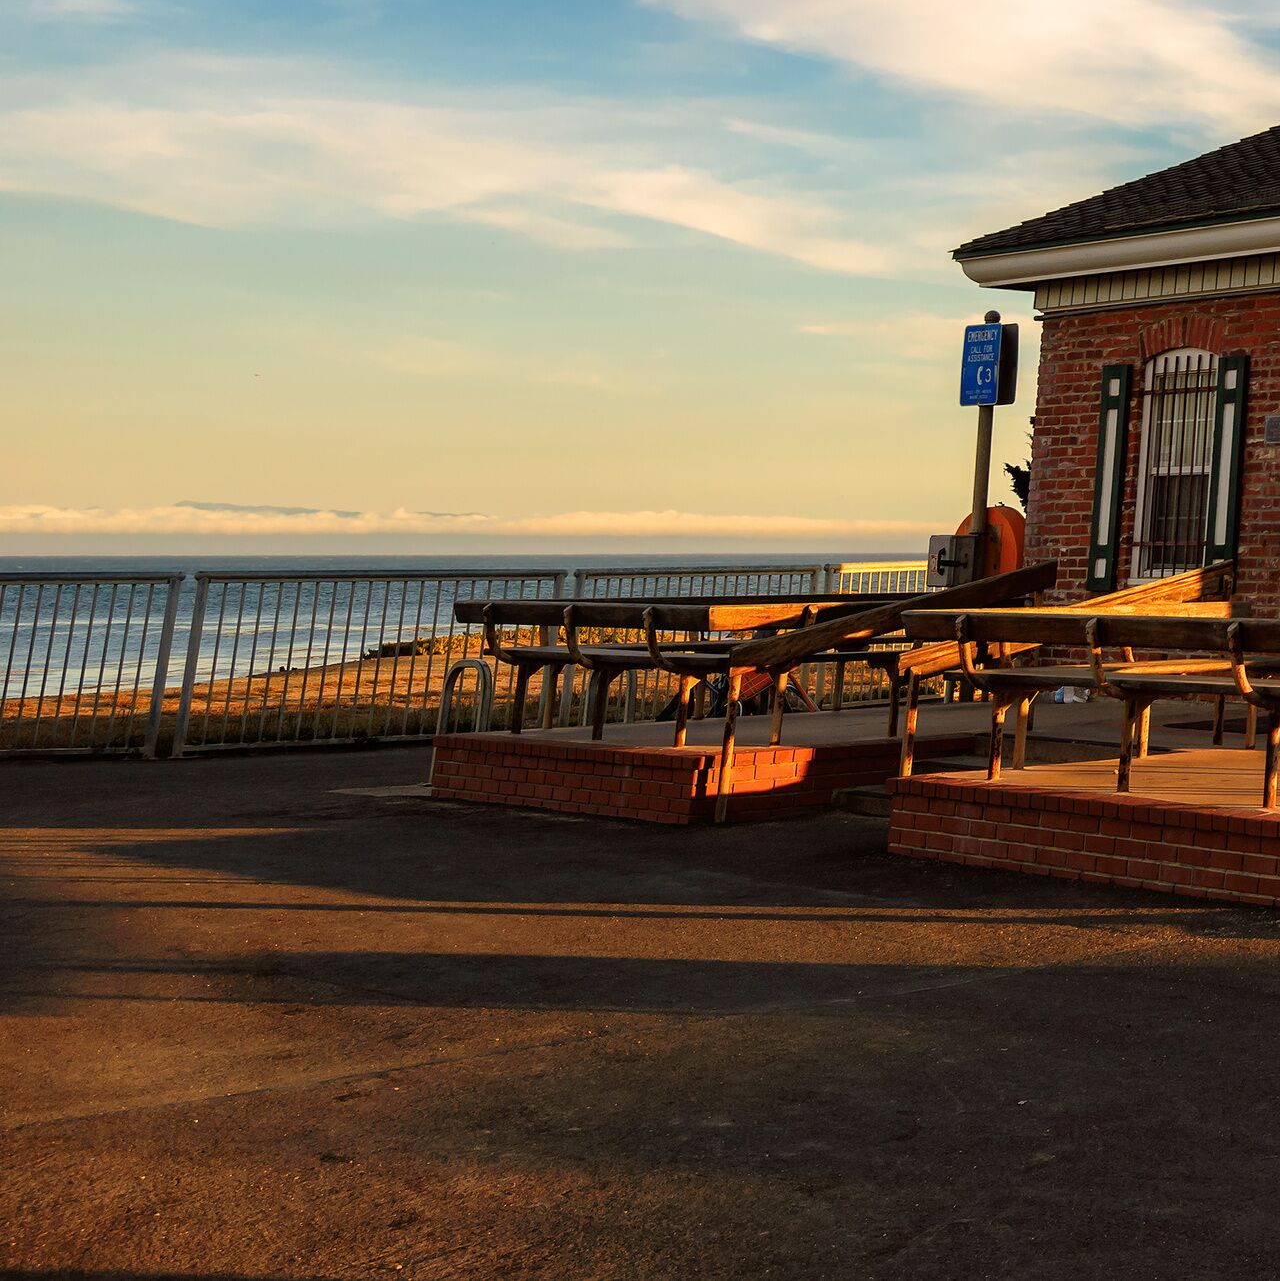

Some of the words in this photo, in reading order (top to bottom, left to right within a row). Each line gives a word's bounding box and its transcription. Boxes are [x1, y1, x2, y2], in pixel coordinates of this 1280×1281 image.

[968, 330, 998, 342] EMERGENCY
[971, 345, 982, 354] CALL
[984, 344, 993, 353] FOR
[968, 353, 994, 362] ASSISTANCE
[985, 368, 992, 383] 3
